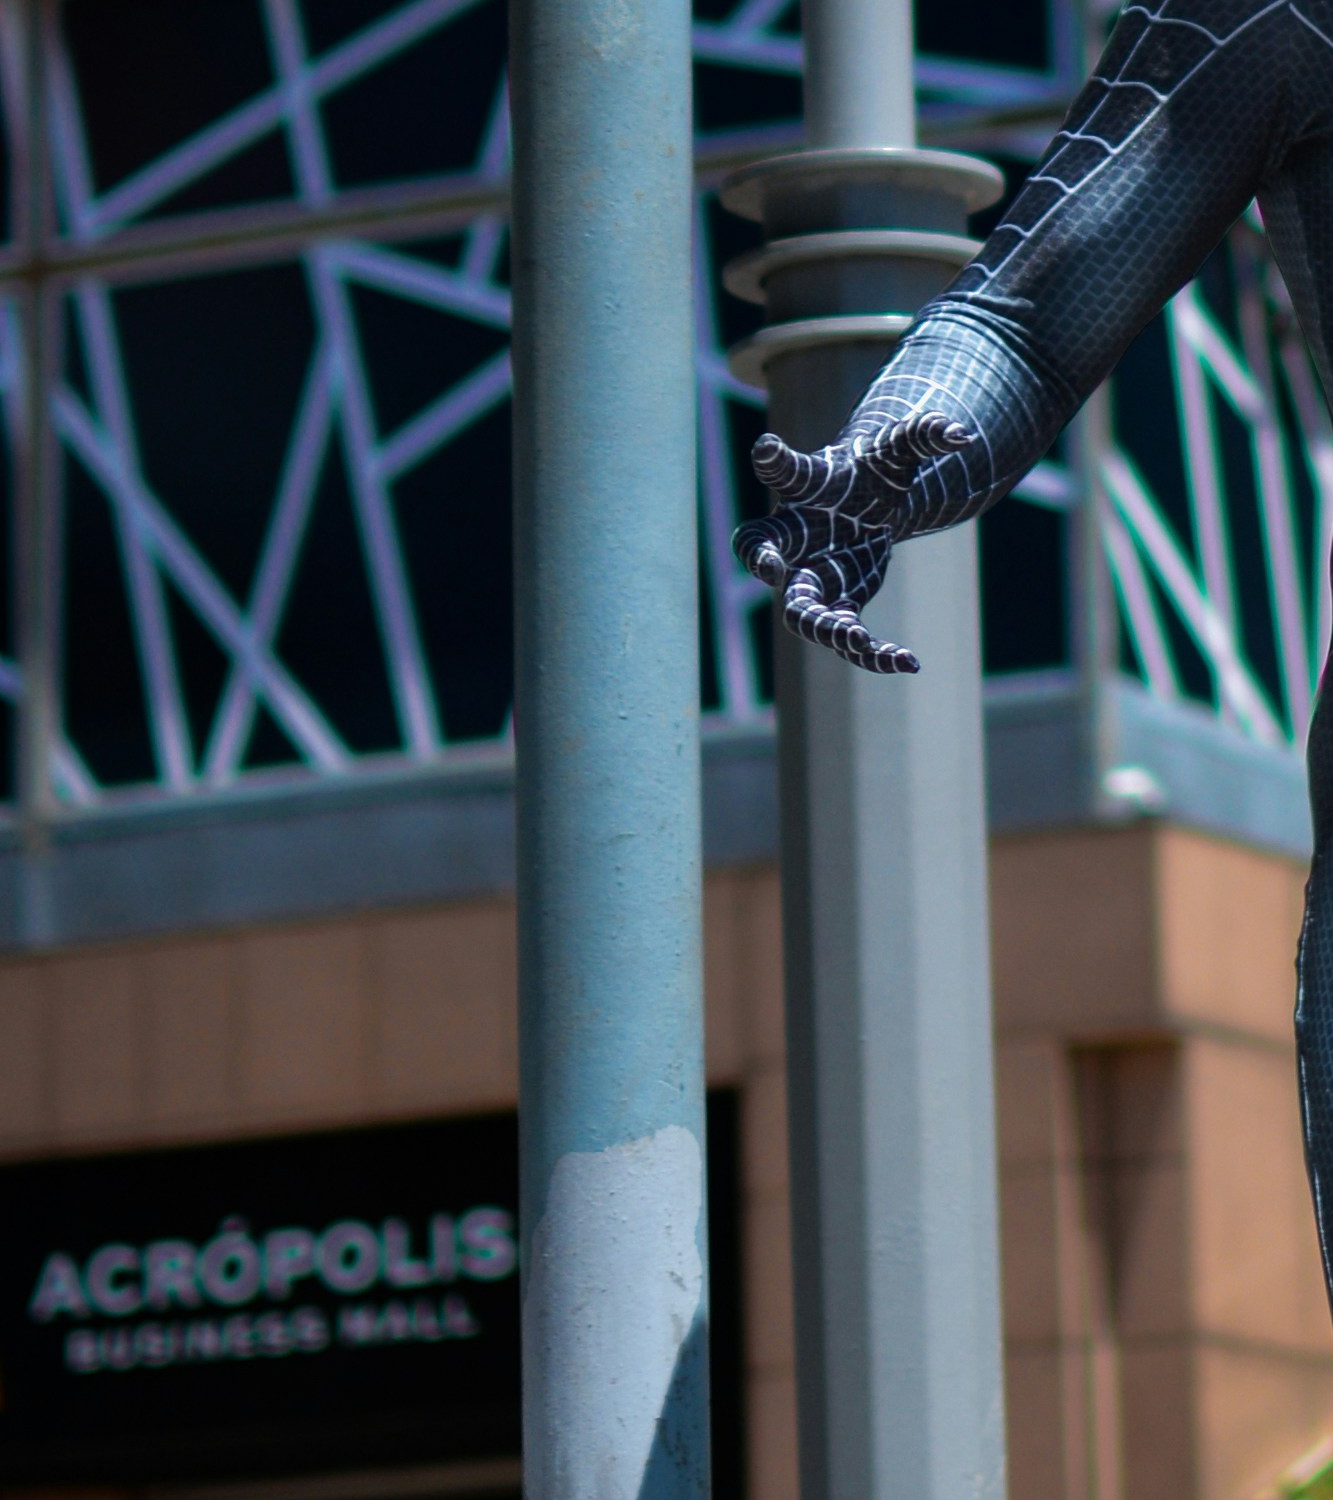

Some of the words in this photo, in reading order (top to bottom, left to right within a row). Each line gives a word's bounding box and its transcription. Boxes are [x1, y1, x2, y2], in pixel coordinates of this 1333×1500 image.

[32, 1208, 516, 1317] ACRÓPOLIS
[67, 1308, 328, 1371] BUSINESS
[338, 1297, 474, 1343] MALL
